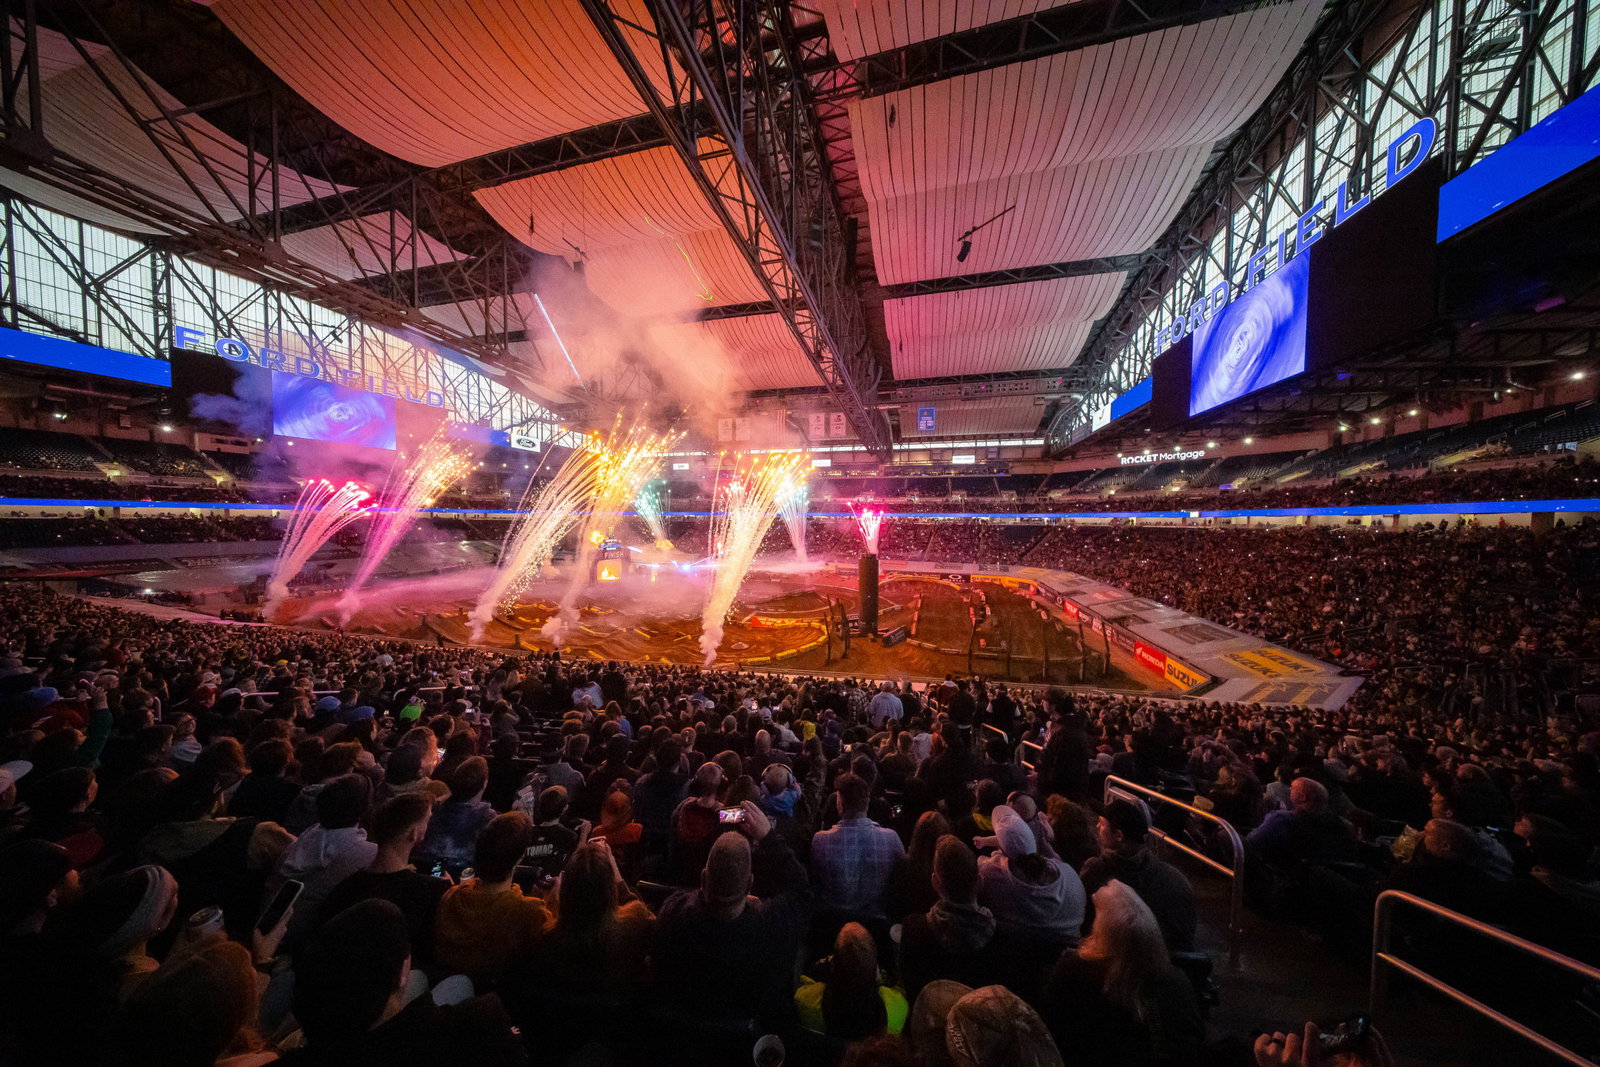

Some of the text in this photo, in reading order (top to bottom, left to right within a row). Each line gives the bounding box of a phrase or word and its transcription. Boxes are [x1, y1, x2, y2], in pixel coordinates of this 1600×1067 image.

[1156, 117, 1437, 356] FORD FIELD
[174, 325, 444, 408] FORD FIELD
[1121, 450, 1205, 465] ROCKET Mortgage
[1141, 650, 1165, 670] HONDA
[1224, 653, 1282, 678] SUZUKI
[1250, 649, 1315, 673] SUZUKI
[526, 844, 554, 856] TOMAC
